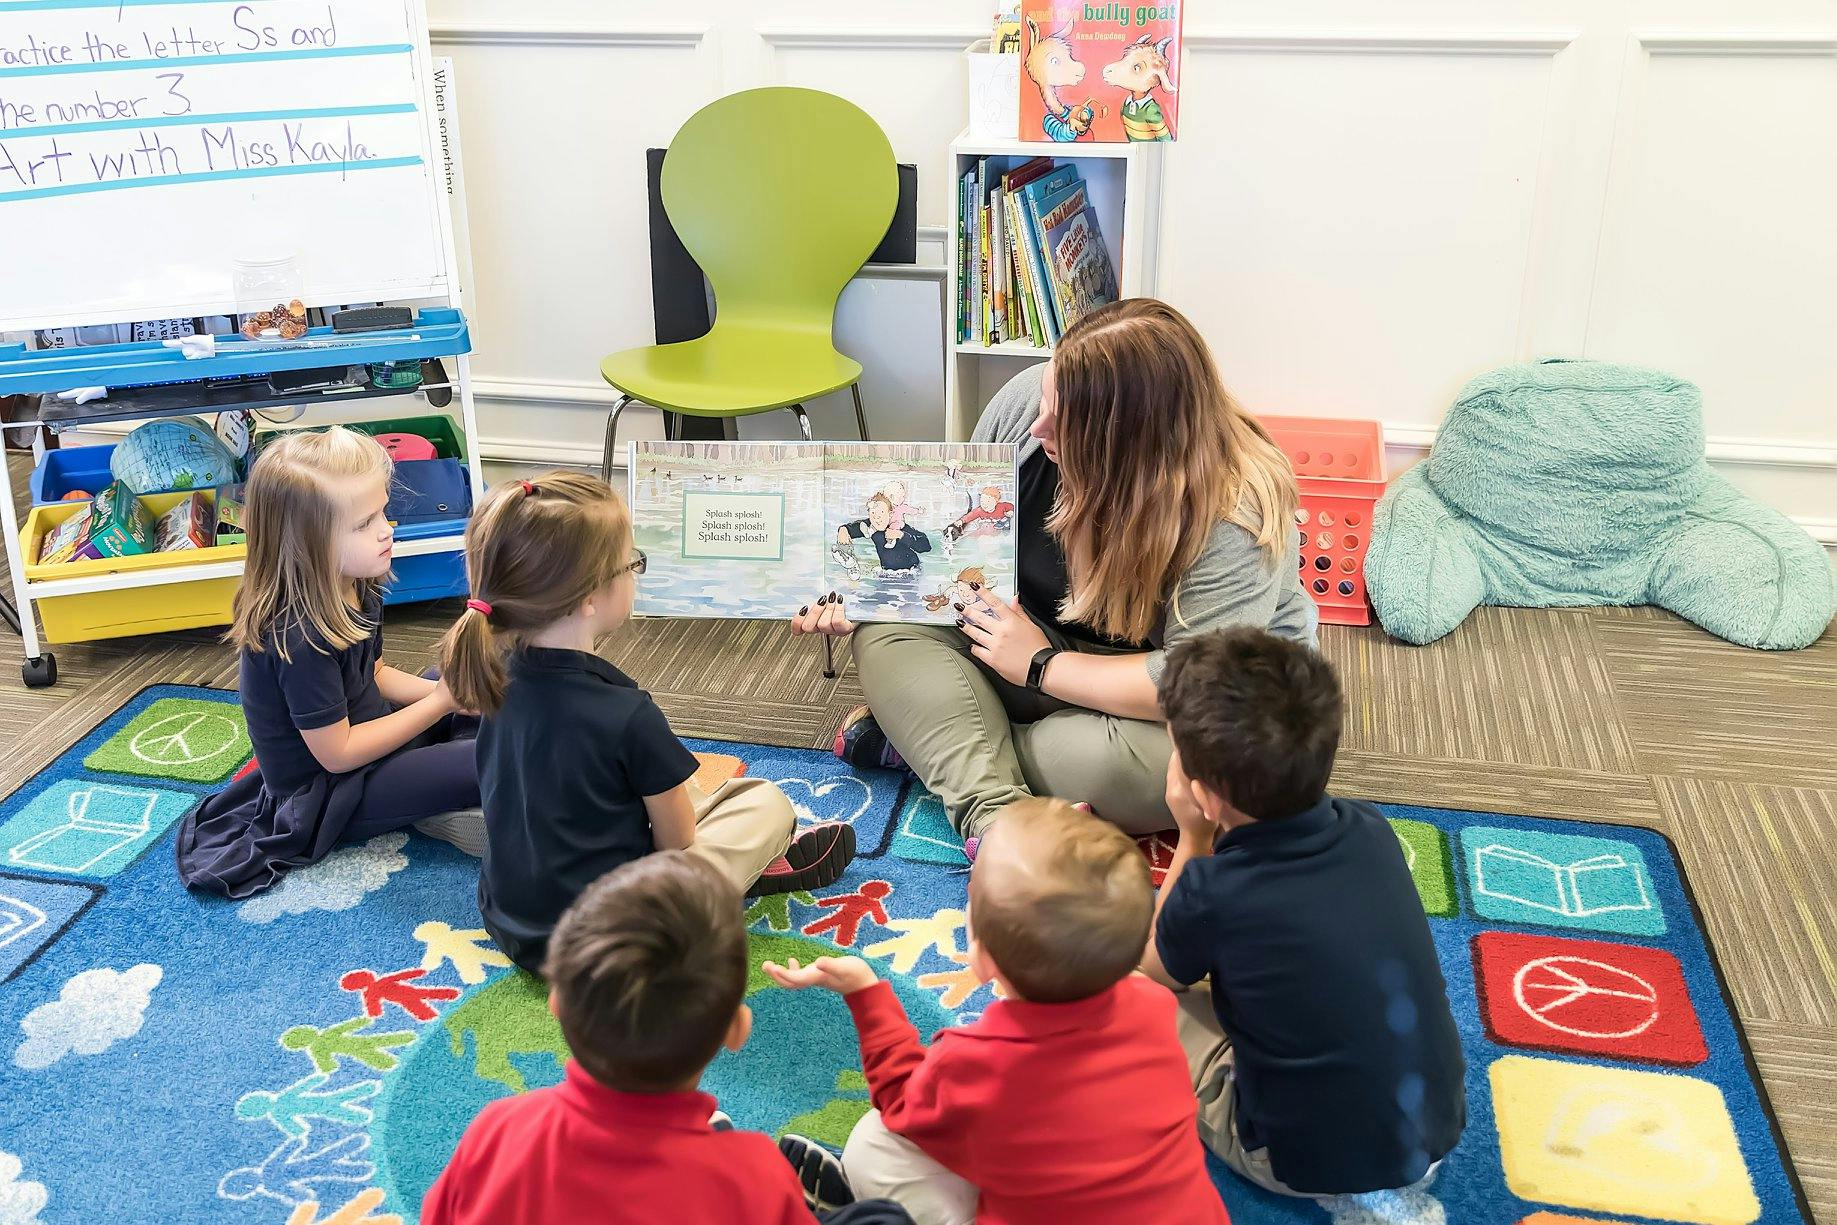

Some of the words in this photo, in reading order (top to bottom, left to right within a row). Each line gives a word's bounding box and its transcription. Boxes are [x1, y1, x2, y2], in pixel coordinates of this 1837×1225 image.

[1083, 3, 1130, 26] bully
[1136, 4, 1176, 26] goat
[82, 31, 130, 62] the
[143, 26, 225, 58] letter
[234, 5, 277, 50] Ss
[292, 4, 336, 47] and
[0, 98, 36, 129] he
[46, 90, 147, 122] number
[156, 73, 191, 115] 3
[433, 69, 447, 112] When
[89, 130, 181, 180] with
[201, 126, 277, 171] Miss
[283, 120, 377, 181] Kayla.
[701, 520, 732, 531] Splash
[734, 521, 766, 532] splosh!
[705, 509, 732, 519] Splash
[734, 510, 763, 520] splosh!
[698, 531, 731, 543] Splash
[734, 532, 768, 543] splosh!
